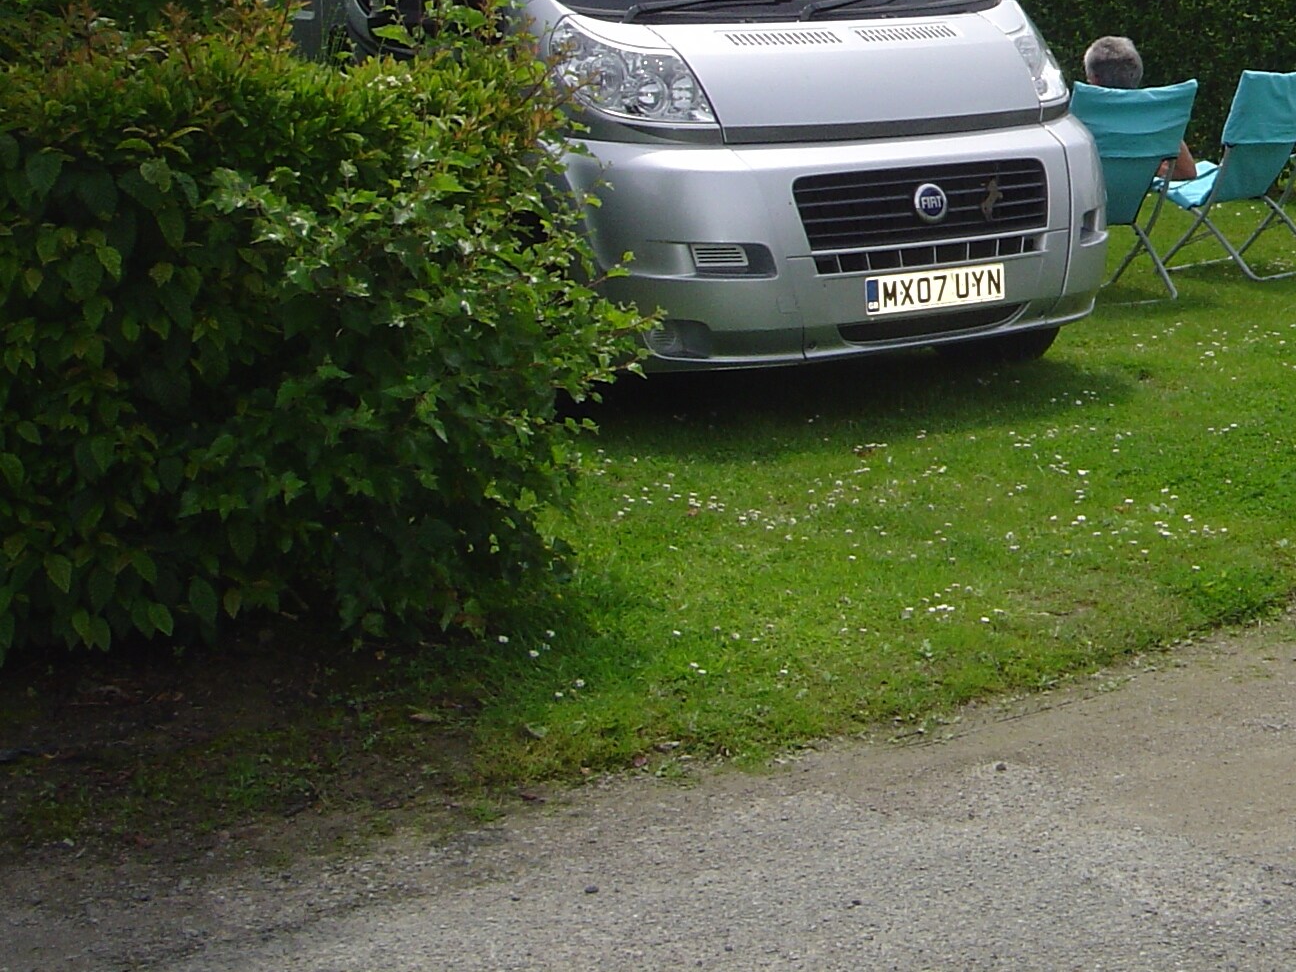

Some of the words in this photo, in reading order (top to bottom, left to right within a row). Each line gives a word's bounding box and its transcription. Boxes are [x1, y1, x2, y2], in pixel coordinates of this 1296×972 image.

[921, 196, 942, 209] FIAT
[883, 274, 947, 307] MX07
[955, 268, 1001, 299] UYN
